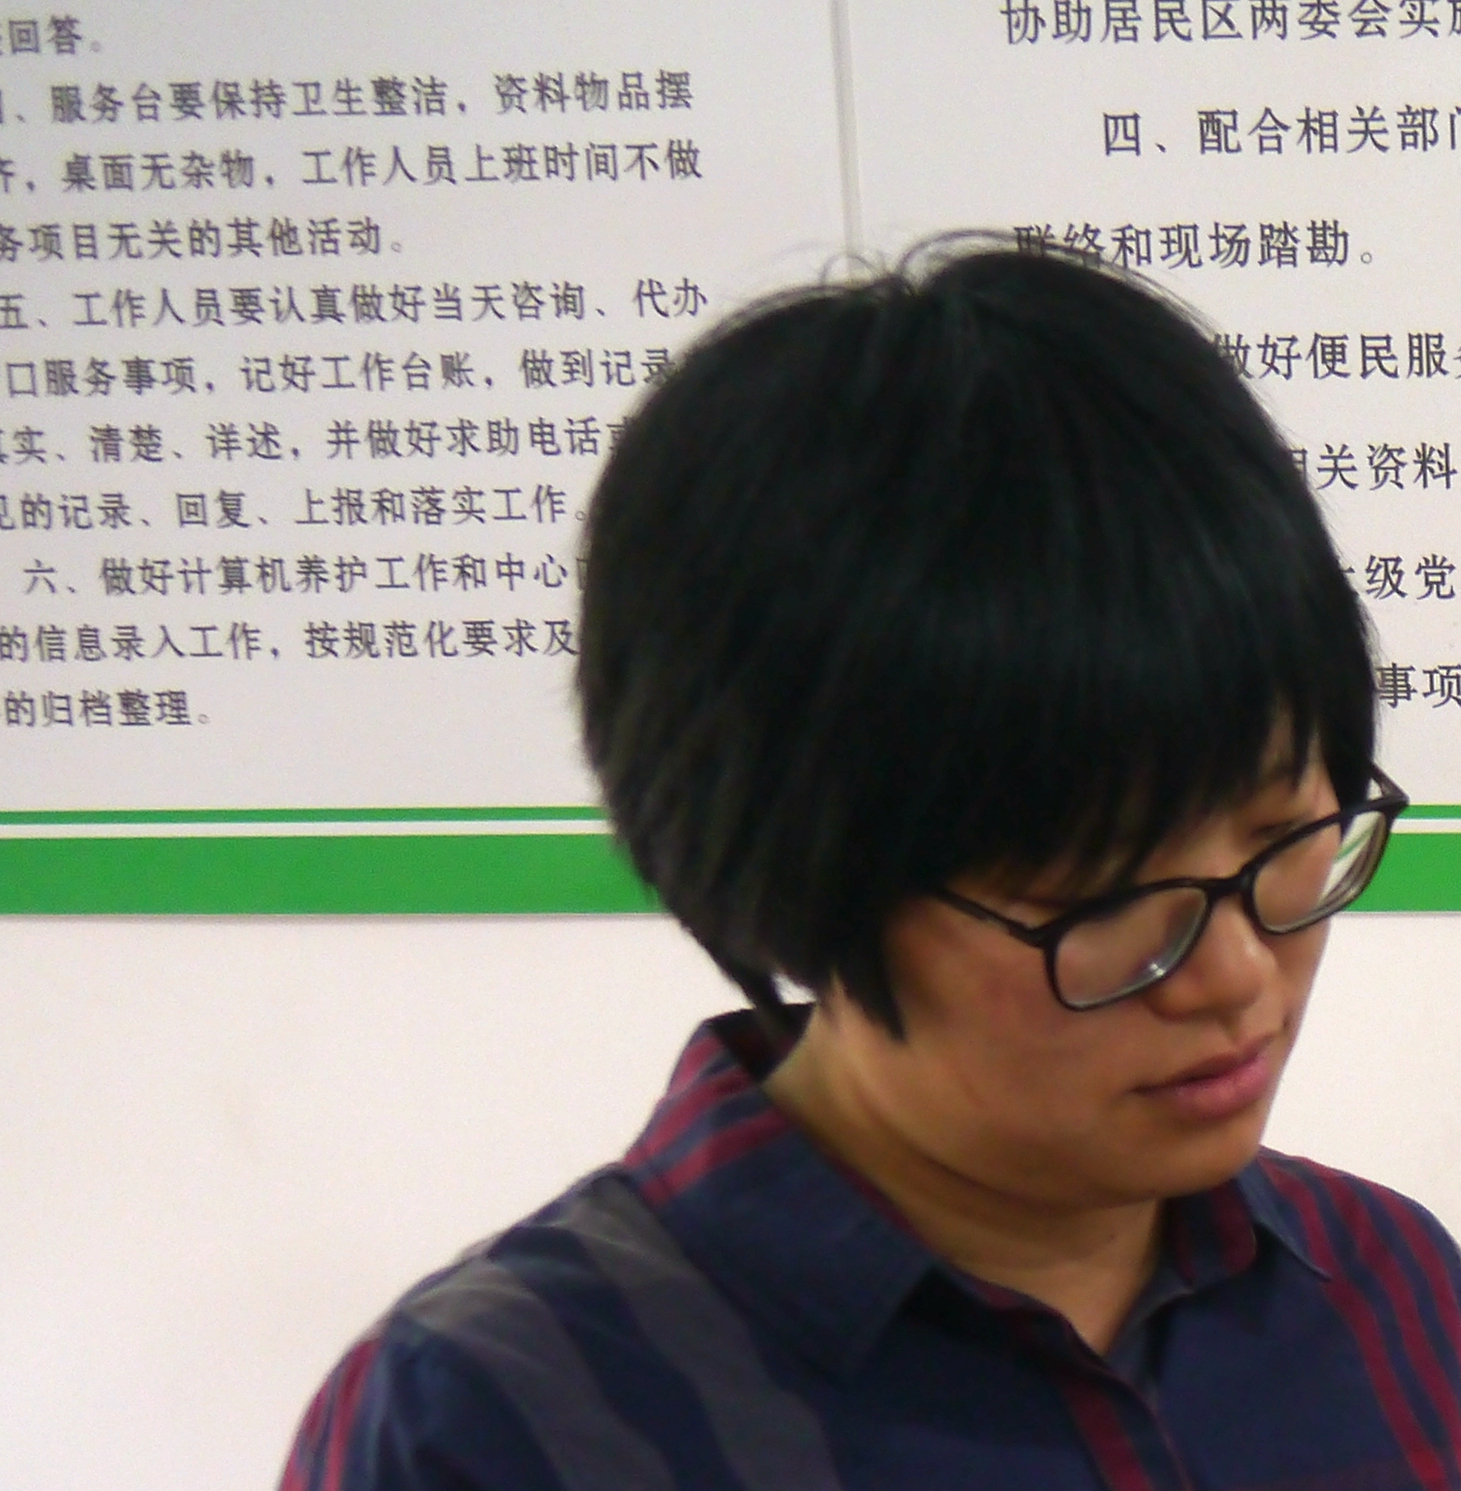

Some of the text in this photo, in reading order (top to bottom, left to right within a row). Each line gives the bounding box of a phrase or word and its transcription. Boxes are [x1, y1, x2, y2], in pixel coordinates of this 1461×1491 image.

[0, 15, 102, 54] 回答。
[0, 70, 693, 124] 、服务台要保持卫生整洁，资料物品摆
[0, 416, 630, 465] 实、清楚、详述，并做好求助电话
